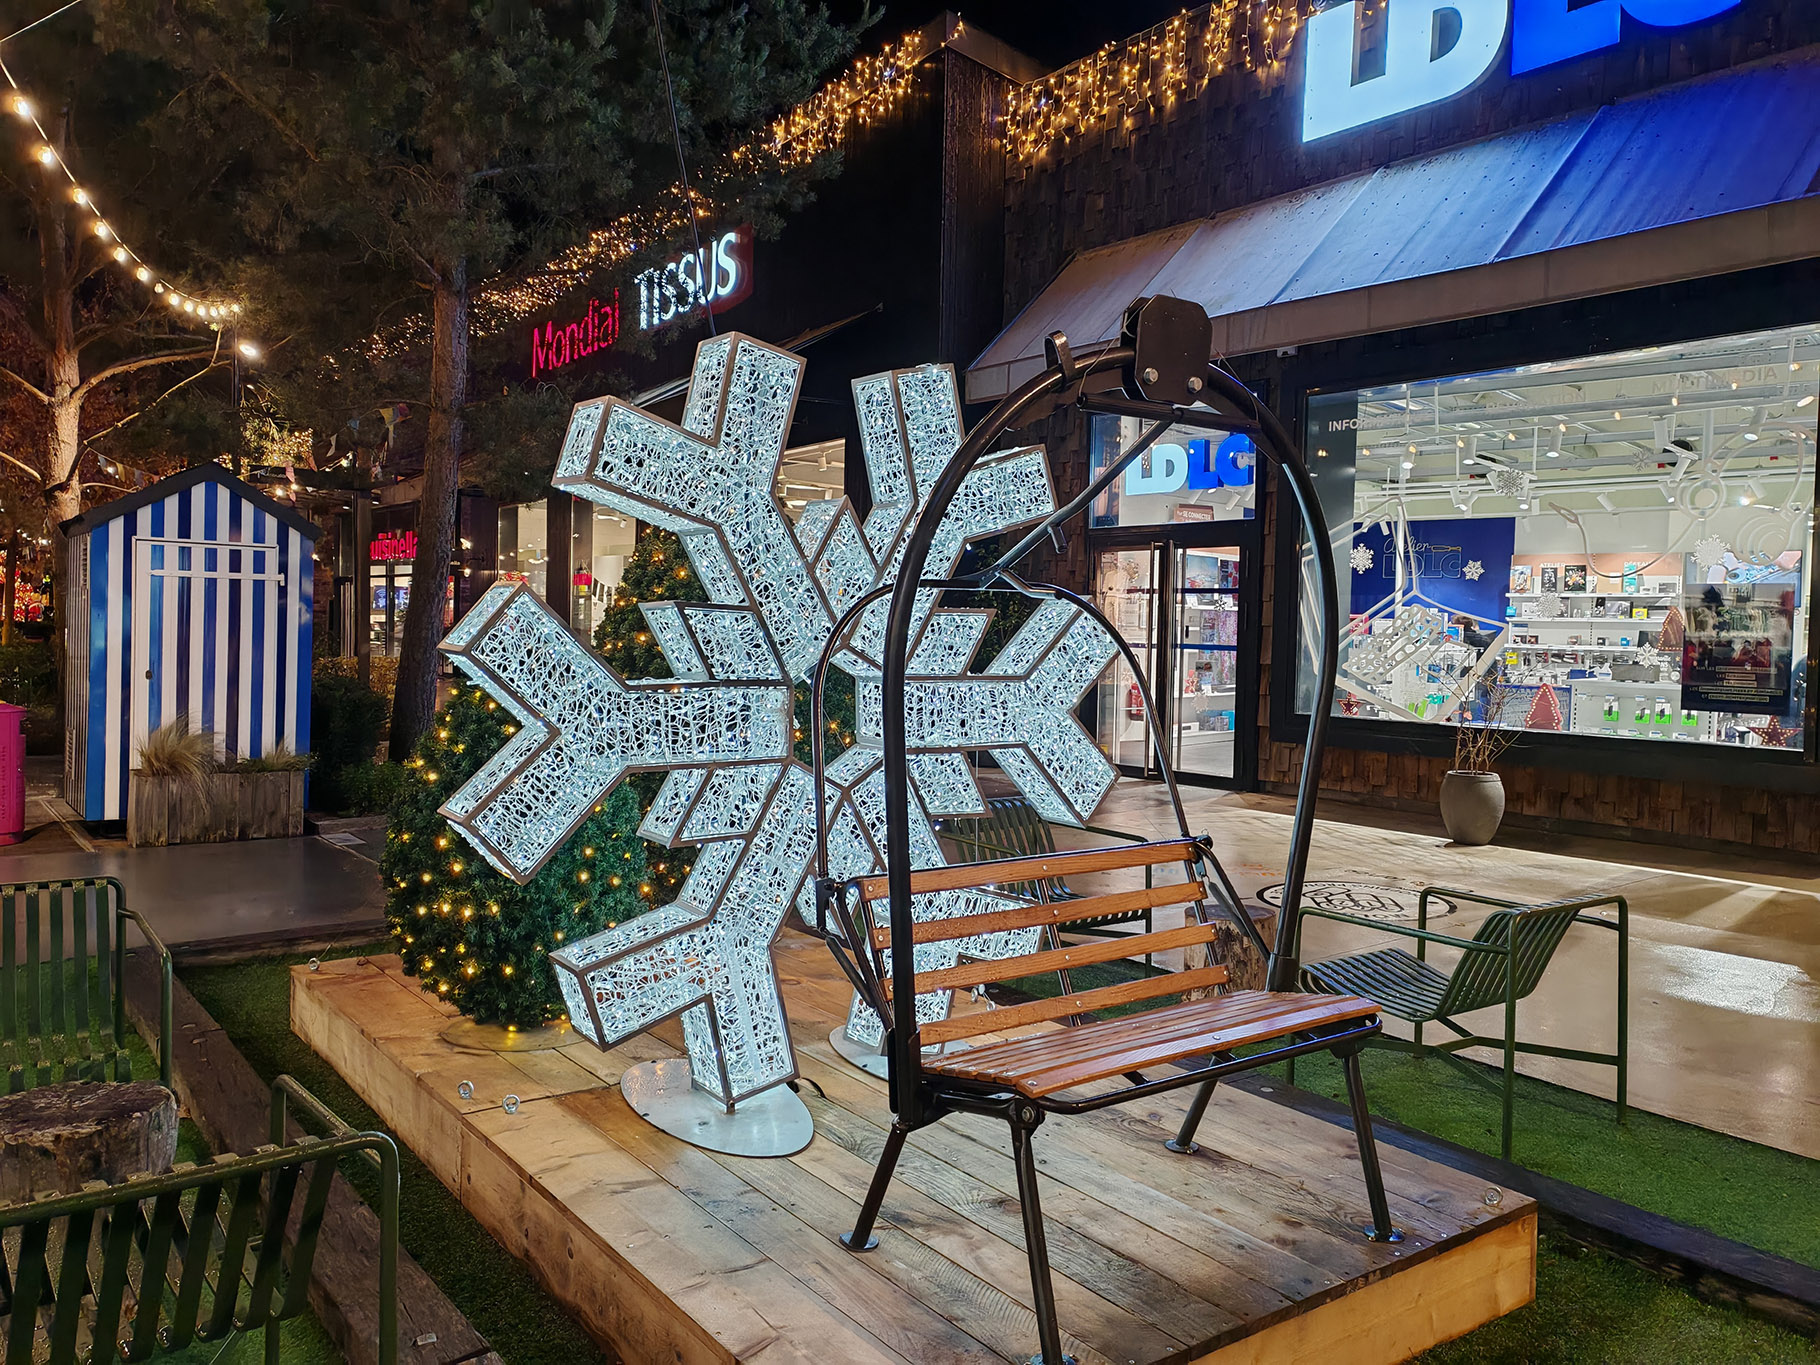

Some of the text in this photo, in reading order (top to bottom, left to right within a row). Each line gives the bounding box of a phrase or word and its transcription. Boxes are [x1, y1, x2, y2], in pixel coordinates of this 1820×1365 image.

[1302, 0, 1741, 142] LDL
[532, 287, 620, 378] Mondial
[1125, 433, 1257, 496] LDLC
[370, 531, 418, 560] uisinella
[1382, 552, 1462, 578] LDLC
[1383, 536, 1432, 553] Aelier
